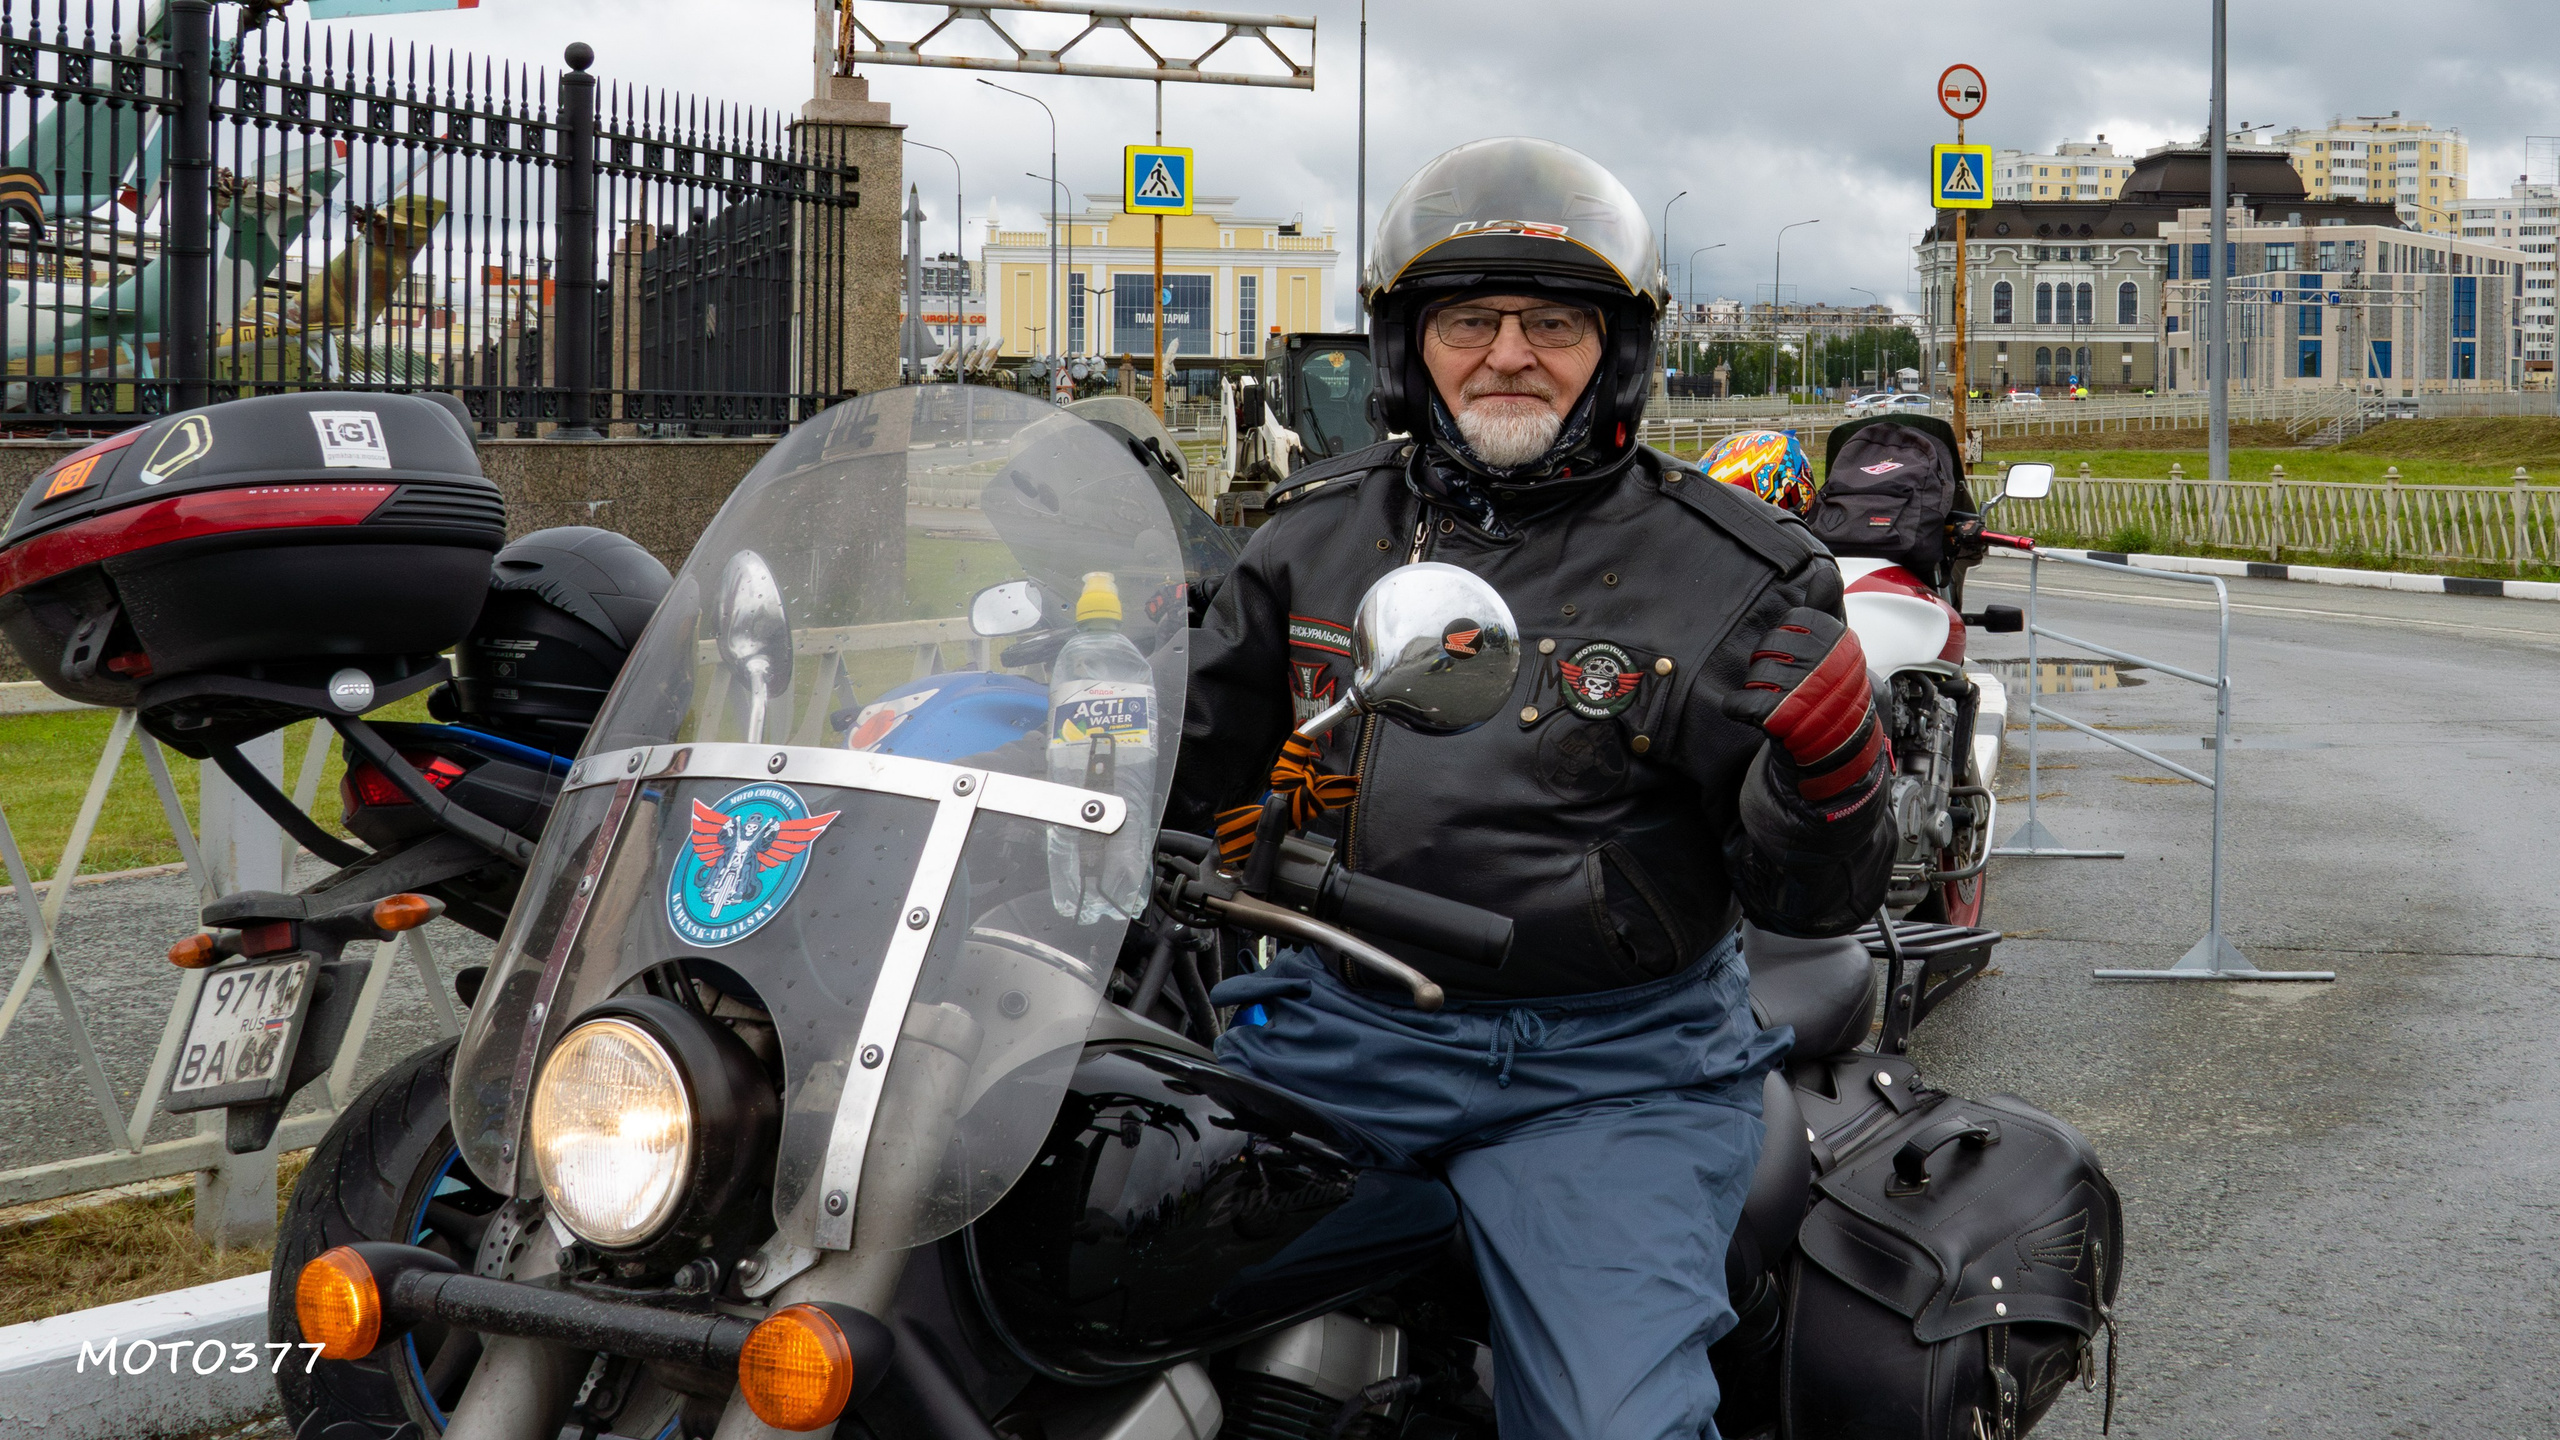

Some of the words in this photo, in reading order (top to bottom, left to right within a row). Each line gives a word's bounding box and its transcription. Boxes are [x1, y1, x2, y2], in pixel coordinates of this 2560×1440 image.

[969, 315, 986, 324] CO
[1135, 311, 1190, 324] ПЛАТАРИЙ
[1056, 396, 1070, 405] 40
[1288, 624, 1351, 647] ЕНСК-УРАЛЬСКИ
[477, 638, 539, 650] LS2
[1445, 643, 1477, 655] HONDA
[1576, 701, 1610, 716] HONDA
[1089, 714, 1132, 726] WATER
[730, 789, 754, 805] MOTO
[754, 788, 797, 811] COMMUNITY
[672, 891, 775, 940] KAMENSK-URALSKY
[214, 965, 294, 1016] 9711
[240, 1016, 267, 1032] RUS
[235, 1031, 280, 1078] 66
